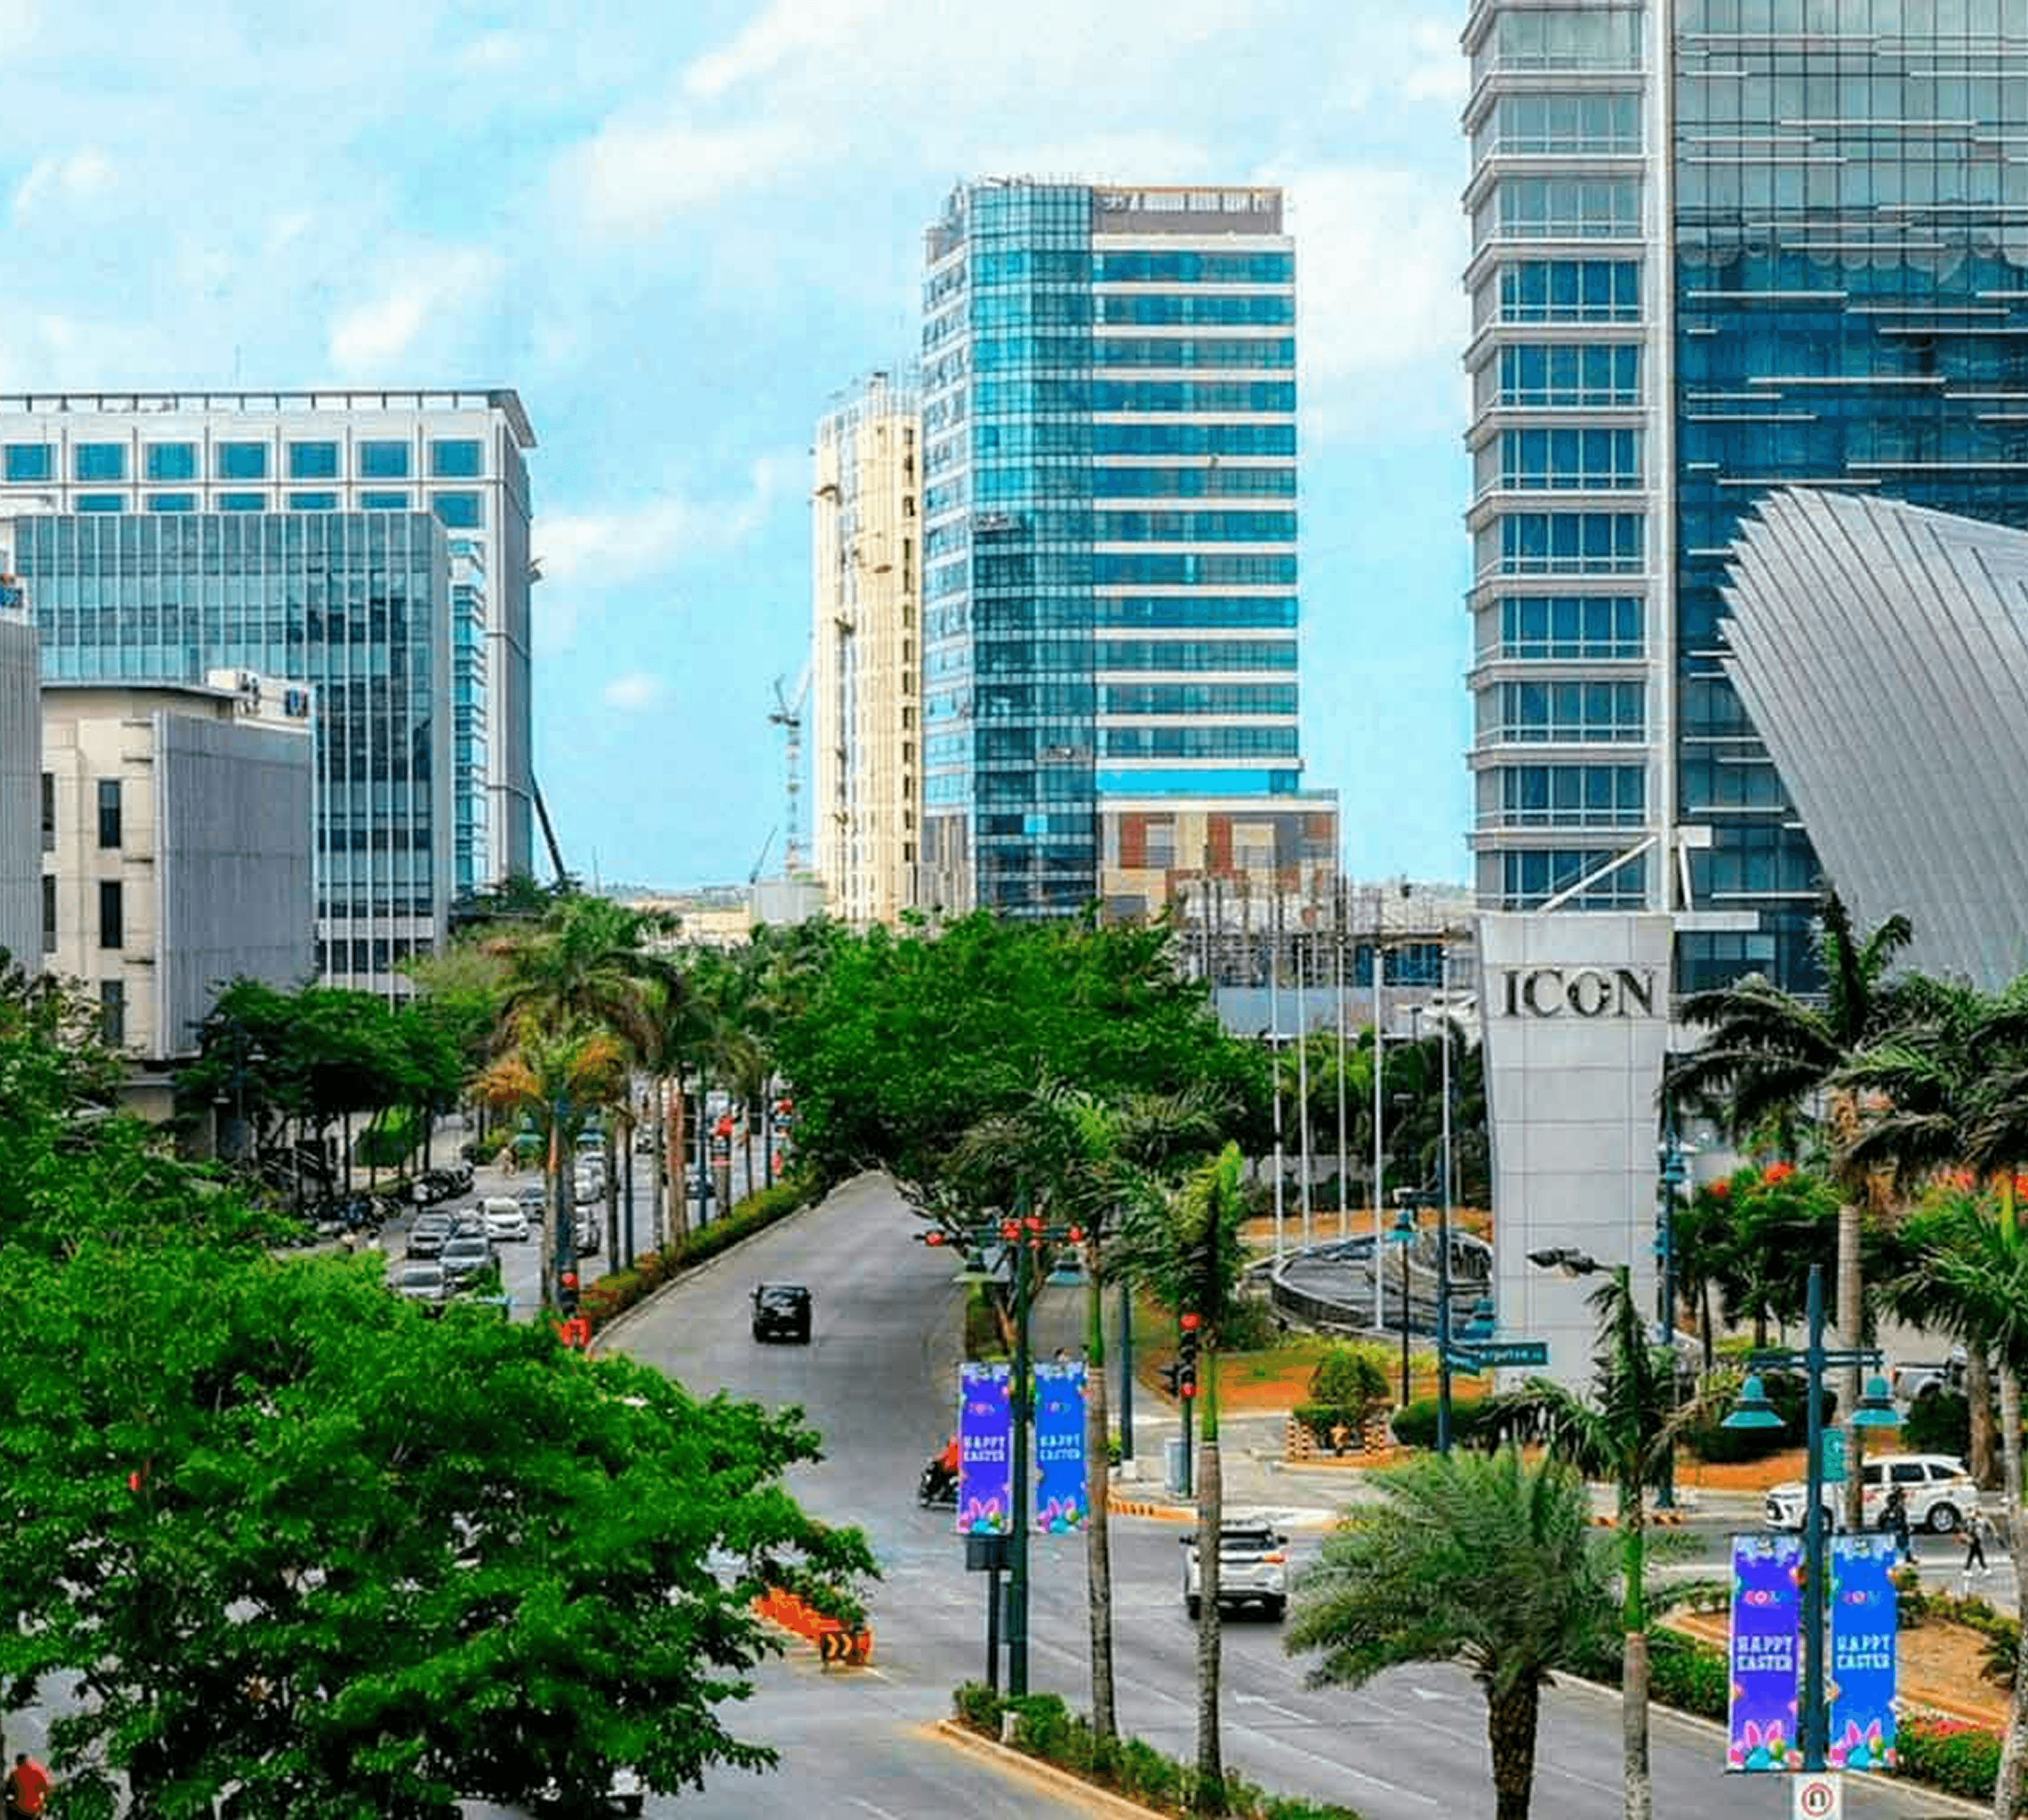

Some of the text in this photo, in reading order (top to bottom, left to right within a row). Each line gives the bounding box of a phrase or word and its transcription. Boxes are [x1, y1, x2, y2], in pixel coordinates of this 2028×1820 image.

[1502, 969, 1657, 1017] ICON
[1737, 1635, 1792, 1652] HAPPY
[1837, 1634, 1890, 1651] HAPPY
[1737, 1654, 1792, 1671] EASTER
[1837, 1653, 1890, 1670] EASTER
